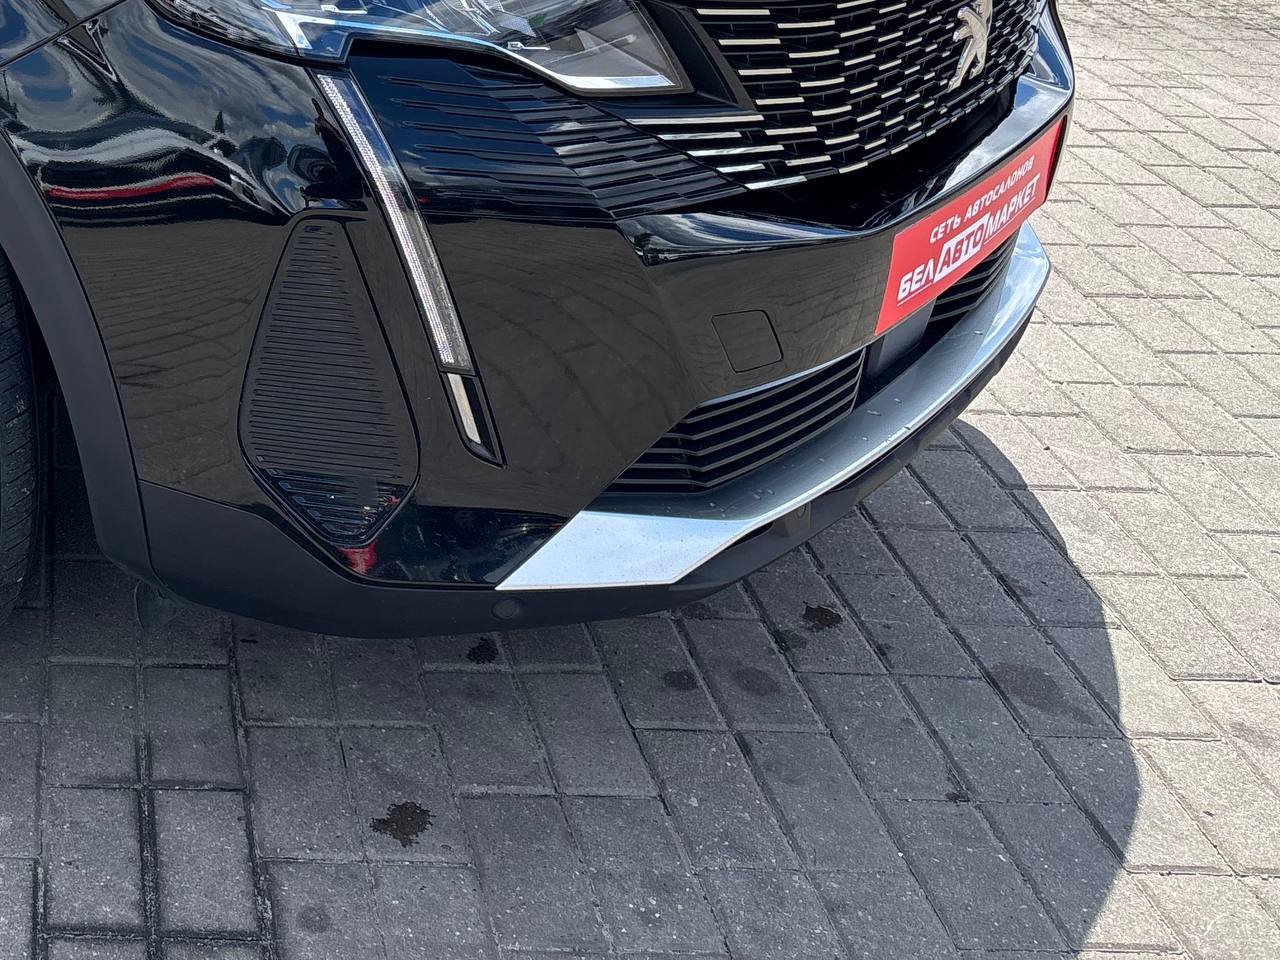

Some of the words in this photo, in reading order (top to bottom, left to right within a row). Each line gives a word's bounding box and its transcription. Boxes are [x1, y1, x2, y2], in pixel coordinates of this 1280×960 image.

[897, 259, 934, 301] БЕЛ
[937, 220, 987, 278] АВТО
[985, 174, 1040, 239] МАРКЕТ
[930, 214, 961, 243] СЕТЬ
[964, 156, 1035, 221] АВТОСАЛОНОВ
